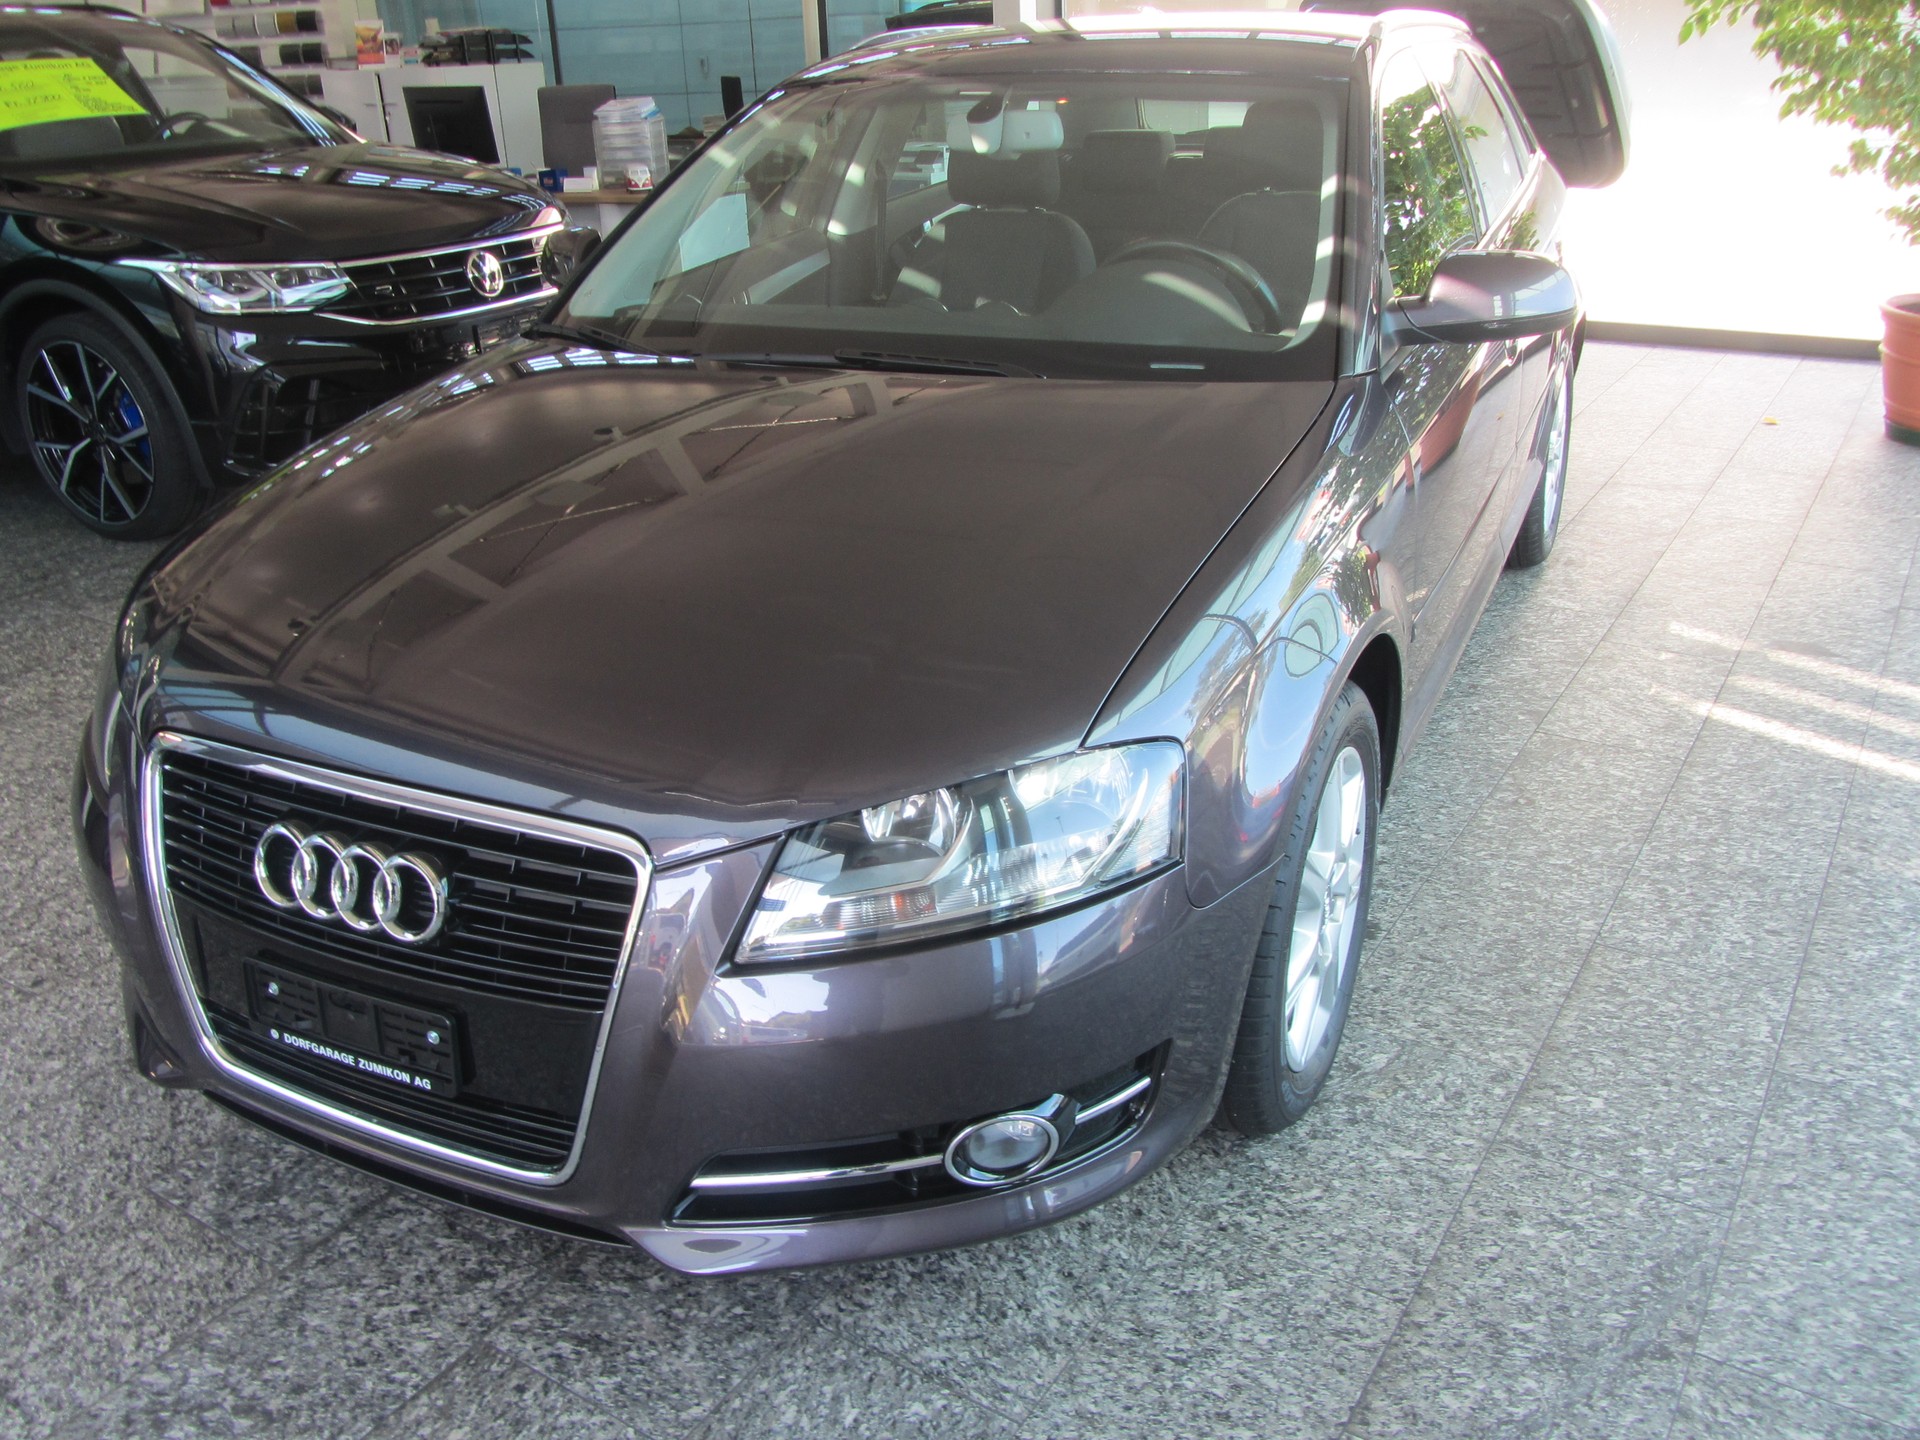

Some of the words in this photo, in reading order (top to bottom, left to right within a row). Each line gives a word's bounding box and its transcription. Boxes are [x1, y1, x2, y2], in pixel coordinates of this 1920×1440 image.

[283, 1032, 355, 1066] DORFGARAGE
[357, 1057, 411, 1084] ZUMIKON
[413, 1075, 432, 1090] AG
